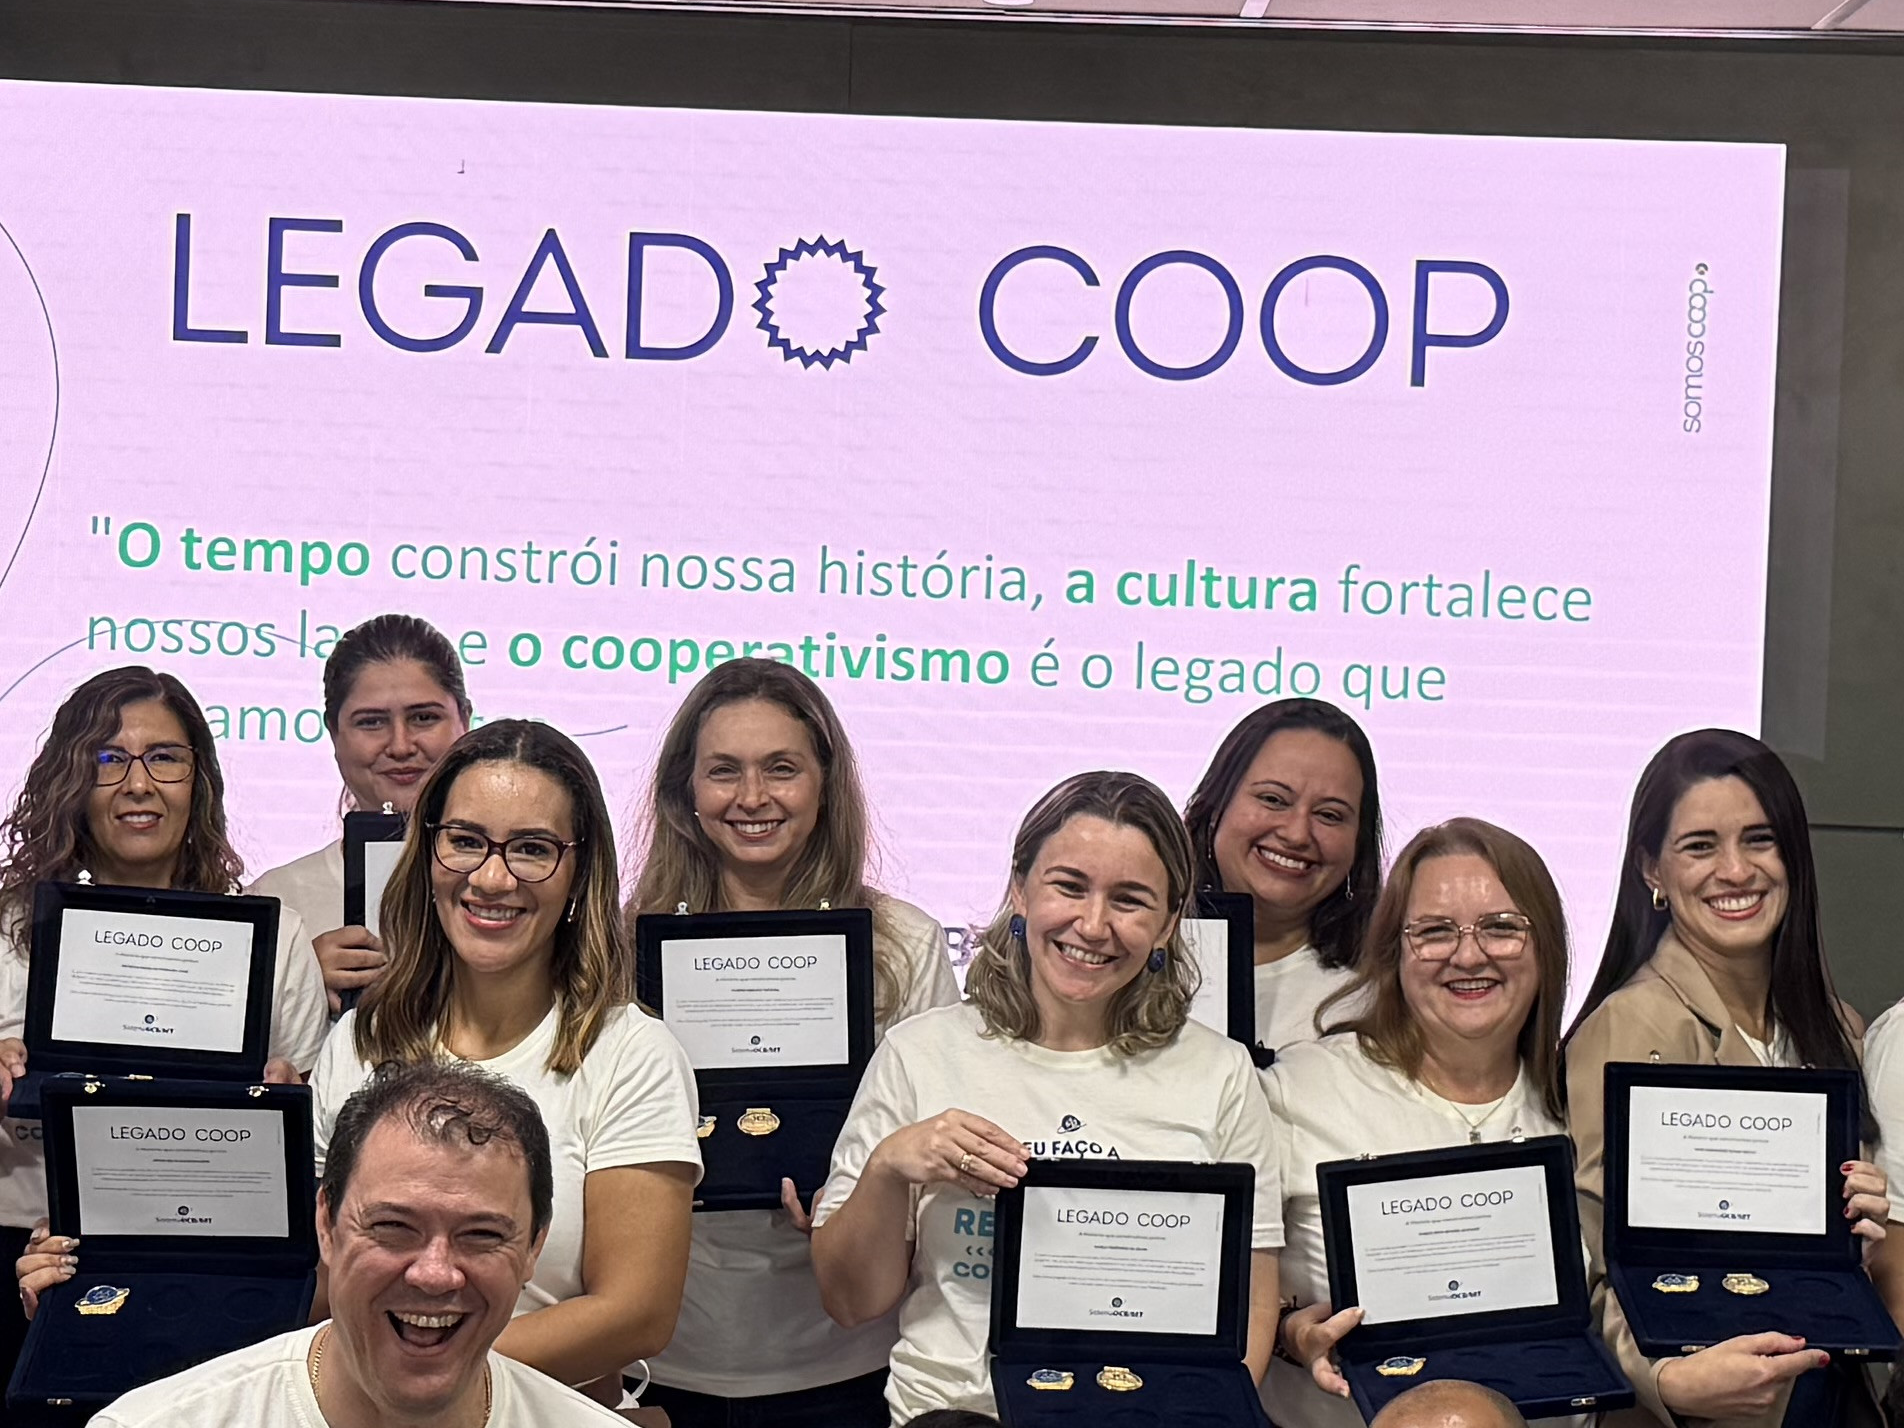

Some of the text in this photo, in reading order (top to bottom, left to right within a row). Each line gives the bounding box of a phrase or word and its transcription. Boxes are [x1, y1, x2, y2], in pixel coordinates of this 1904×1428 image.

[170, 212, 1511, 387] LEGADO COOP
[179, 527, 370, 586] tempo
[391, 537, 620, 589] constrói
[640, 549, 795, 596] nossa
[818, 545, 1045, 612] história,
[1064, 570, 1096, 606] a
[1116, 559, 1318, 613] cultura
[1338, 564, 1593, 623] fortalece
[88, 616, 276, 658] nossos
[459, 630, 488, 665] e
[508, 631, 541, 668] o
[1031, 638, 1059, 688] é
[1081, 651, 1114, 690] o
[1137, 643, 1322, 704] legado
[1342, 665, 1448, 710] que
[95, 930, 222, 953] LEGADO COOP
[694, 956, 817, 970] LEGADO COOP
[1661, 1112, 1792, 1131] LEGADO COOP
[111, 1126, 251, 1142] LEGADO COOP
[1052, 1140, 1102, 1158] FAÇO
[1108, 1146, 1120, 1159] A
[1382, 1190, 1513, 1215] LEGADO COOP
[1057, 1209, 1190, 1228] LEGADO COOP
